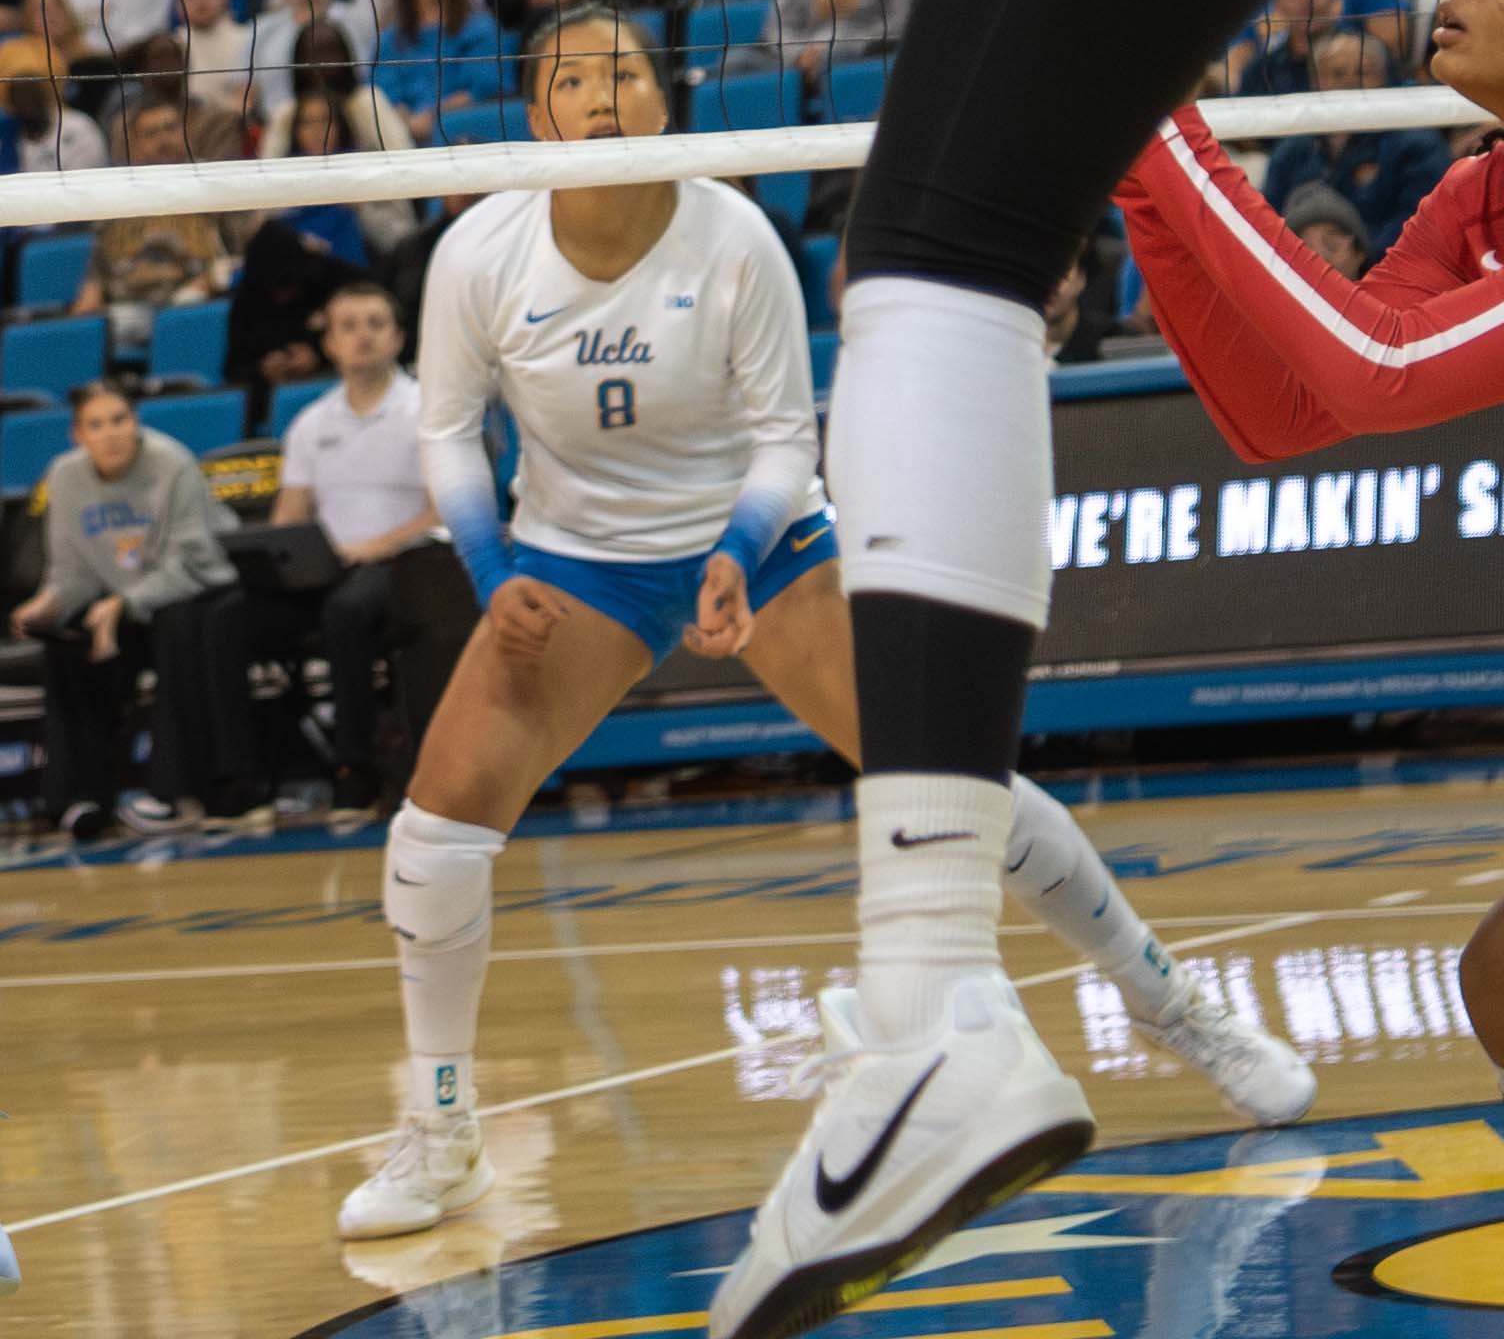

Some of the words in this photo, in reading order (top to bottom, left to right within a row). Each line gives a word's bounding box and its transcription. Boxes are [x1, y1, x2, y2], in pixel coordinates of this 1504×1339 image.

[575, 326, 654, 367] Ucla
[596, 377, 637, 430] 8
[1216, 464, 1440, 558] MAKIN'
